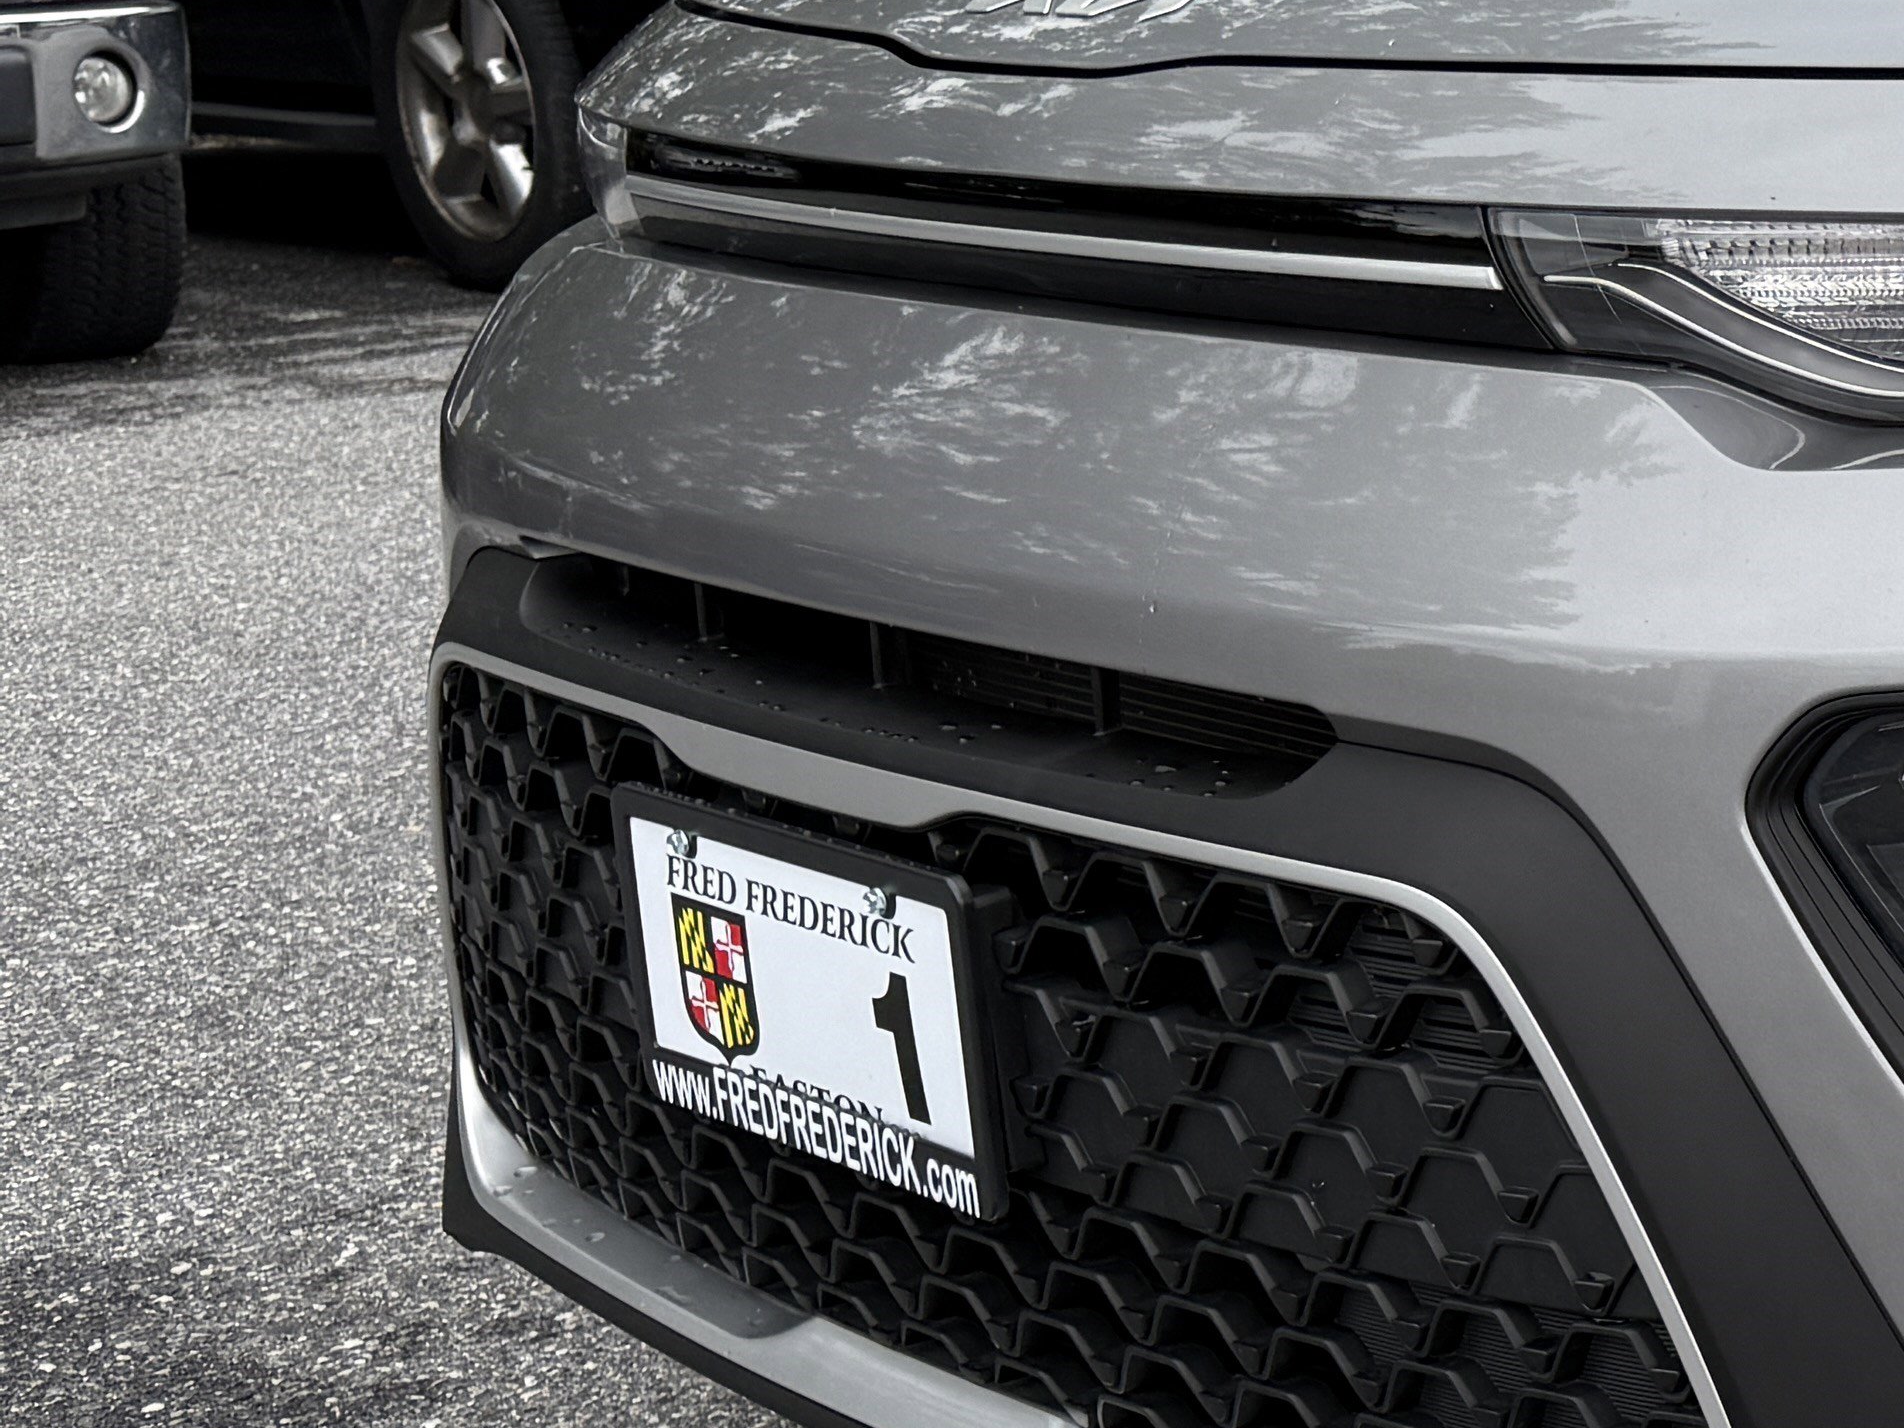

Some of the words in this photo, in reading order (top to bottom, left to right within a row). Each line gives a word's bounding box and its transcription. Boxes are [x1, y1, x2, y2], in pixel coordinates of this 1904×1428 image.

[666, 853, 738, 906] FRED
[745, 877, 917, 964] FREDERICK
[871, 970, 933, 1127] 1
[652, 1058, 982, 1220] www.FREDFREDERICK.com
